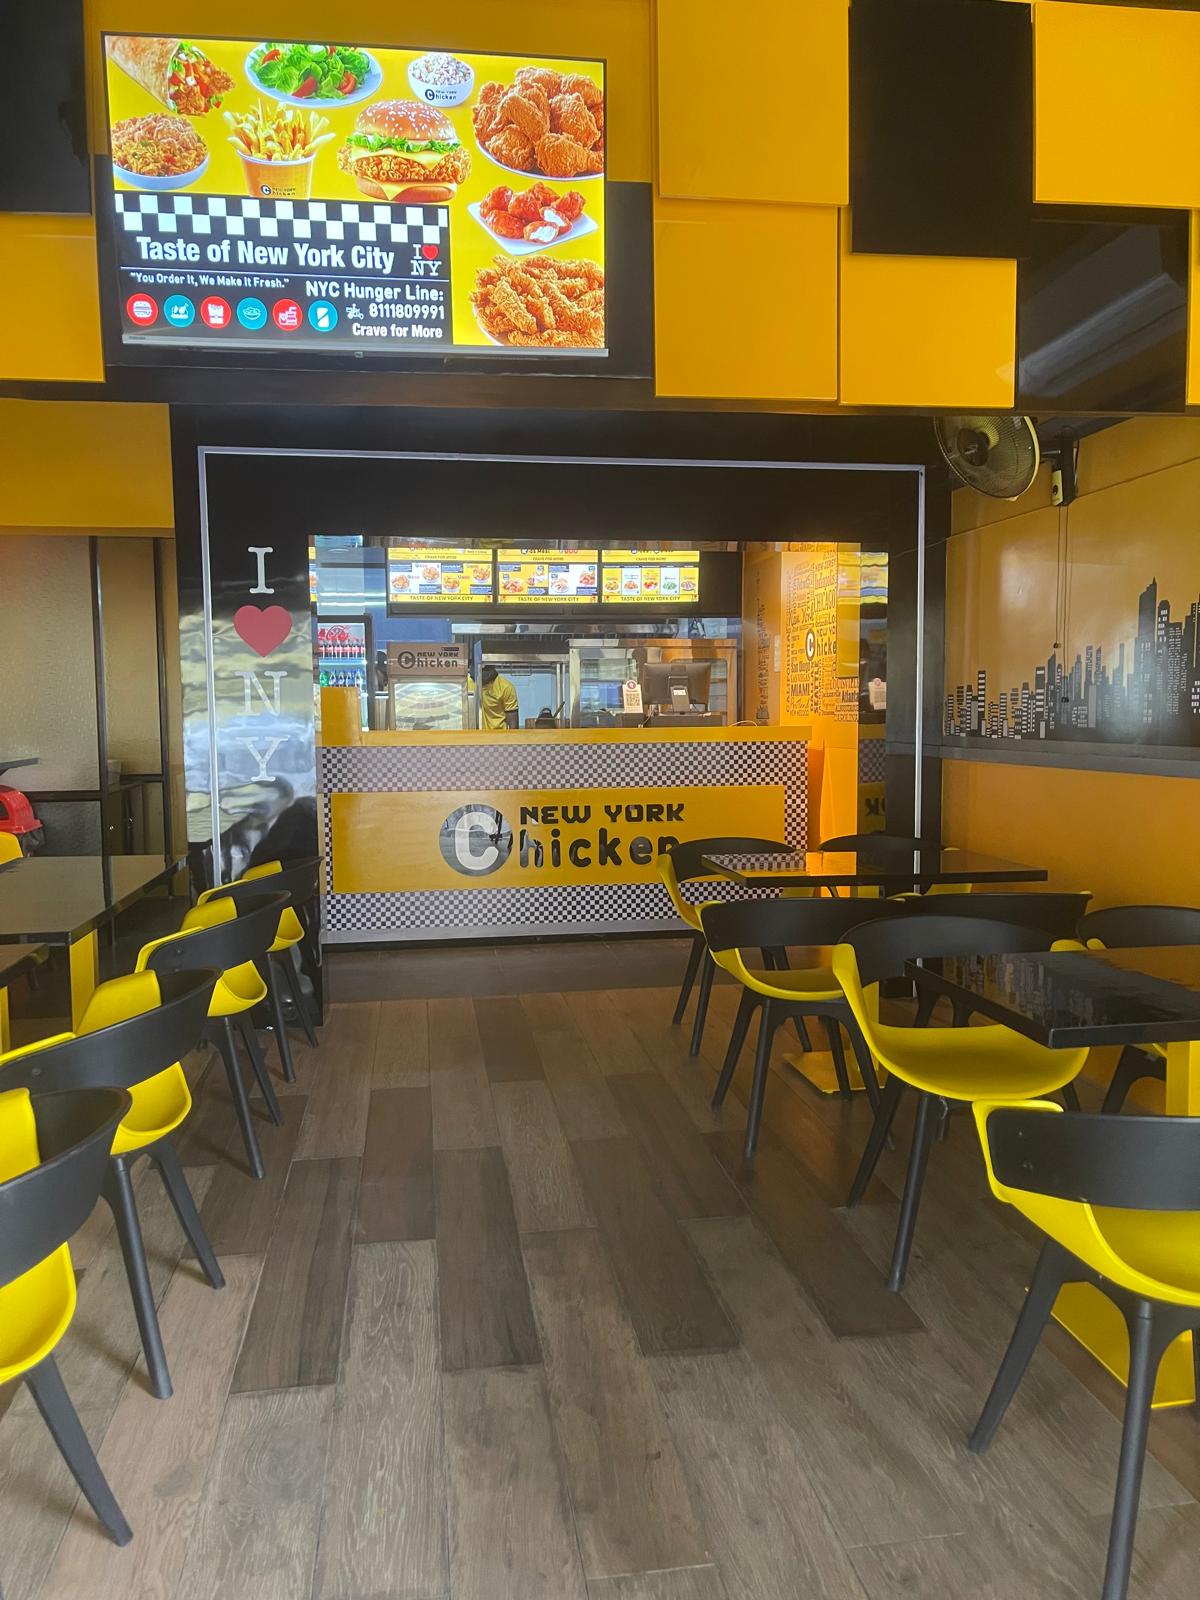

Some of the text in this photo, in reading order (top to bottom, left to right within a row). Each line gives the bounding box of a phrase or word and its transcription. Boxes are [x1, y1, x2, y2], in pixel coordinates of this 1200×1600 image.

[136, 236, 394, 274] Taste of New York City
[413, 244, 422, 260] I
[410, 260, 442, 276] NY
[156, 273, 185, 284] Order
[200, 274, 216, 285] We
[217, 275, 242, 286] Make
[306, 280, 444, 302] NYC Hunger Line:
[369, 303, 444, 320] 8111809991
[352, 322, 443, 339] Crave for More
[247, 546, 274, 594] I
[398, 651, 458, 669] Chicken
[791, 683, 810, 696] MIAMI
[520, 803, 685, 825] NEW YORK
